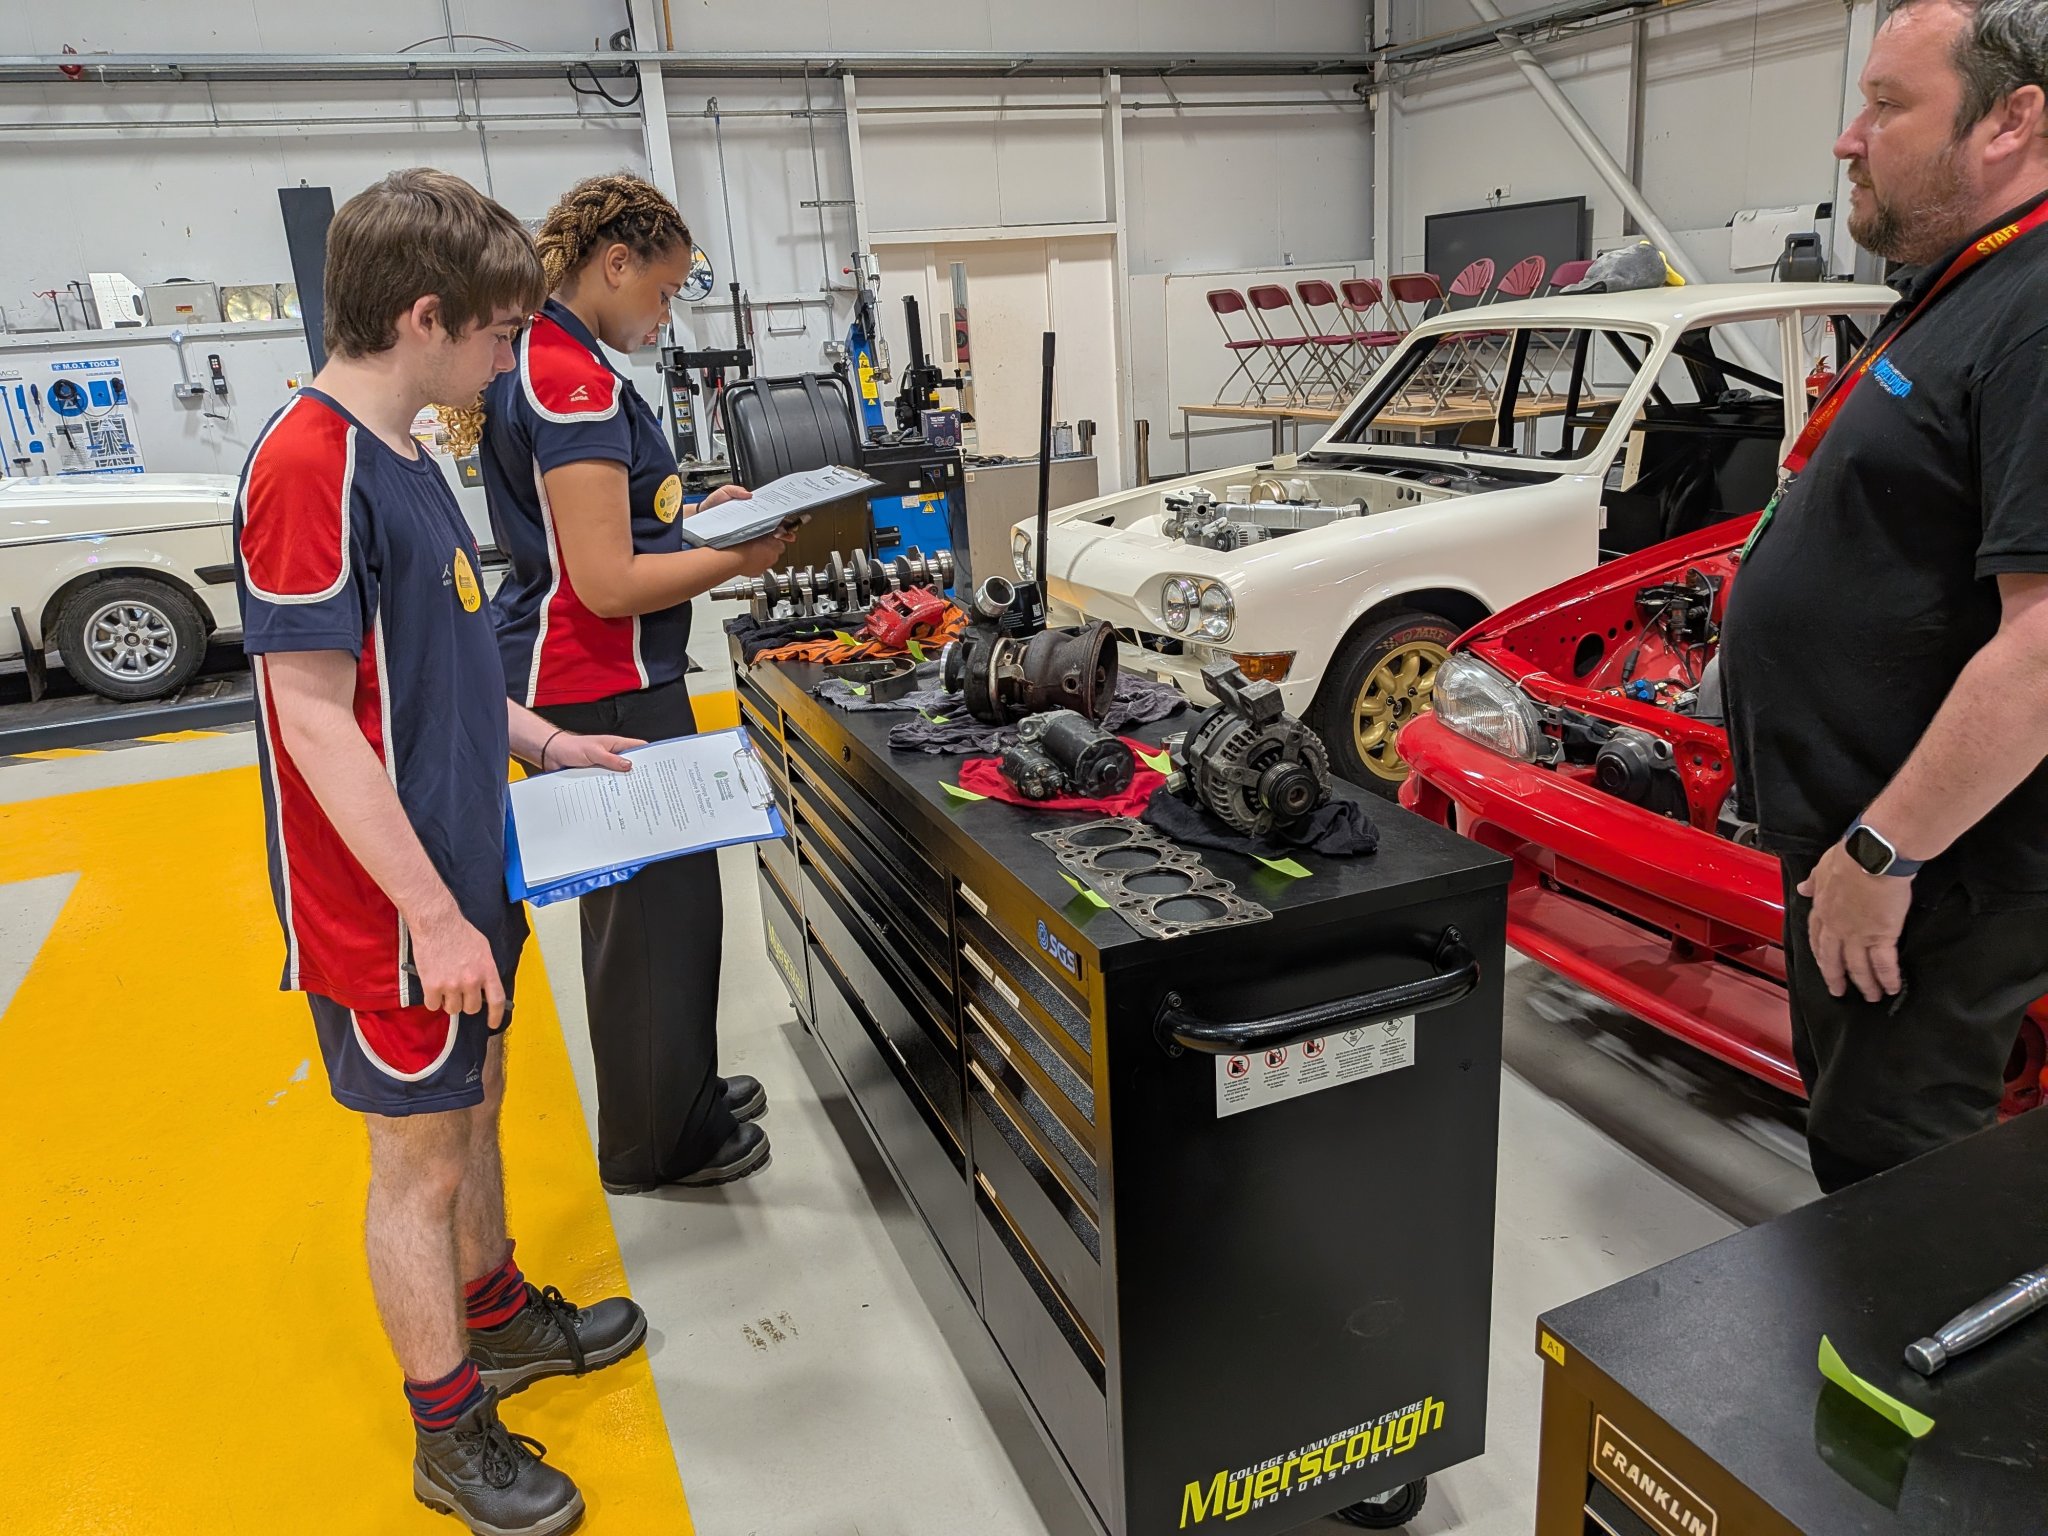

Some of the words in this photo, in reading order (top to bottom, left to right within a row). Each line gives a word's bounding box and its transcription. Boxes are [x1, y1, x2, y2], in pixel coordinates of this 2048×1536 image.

[1976, 223, 2020, 255] STAFF
[89, 360, 116, 368] TOOLS
[1049, 934, 1076, 974] SGS
[1547, 1341, 1560, 1357] A1
[1179, 1396, 1446, 1529] Myerscough
[1229, 1455, 1285, 1483] COLLEGE
[1287, 1449, 1297, 1461] &
[1300, 1418, 1375, 1456] UNIVERSITY
[1377, 1400, 1424, 1426] CENTRE
[1252, 1448, 1396, 1511] MOTORSPORT
[1601, 1440, 1708, 1536] FRANKLIN
